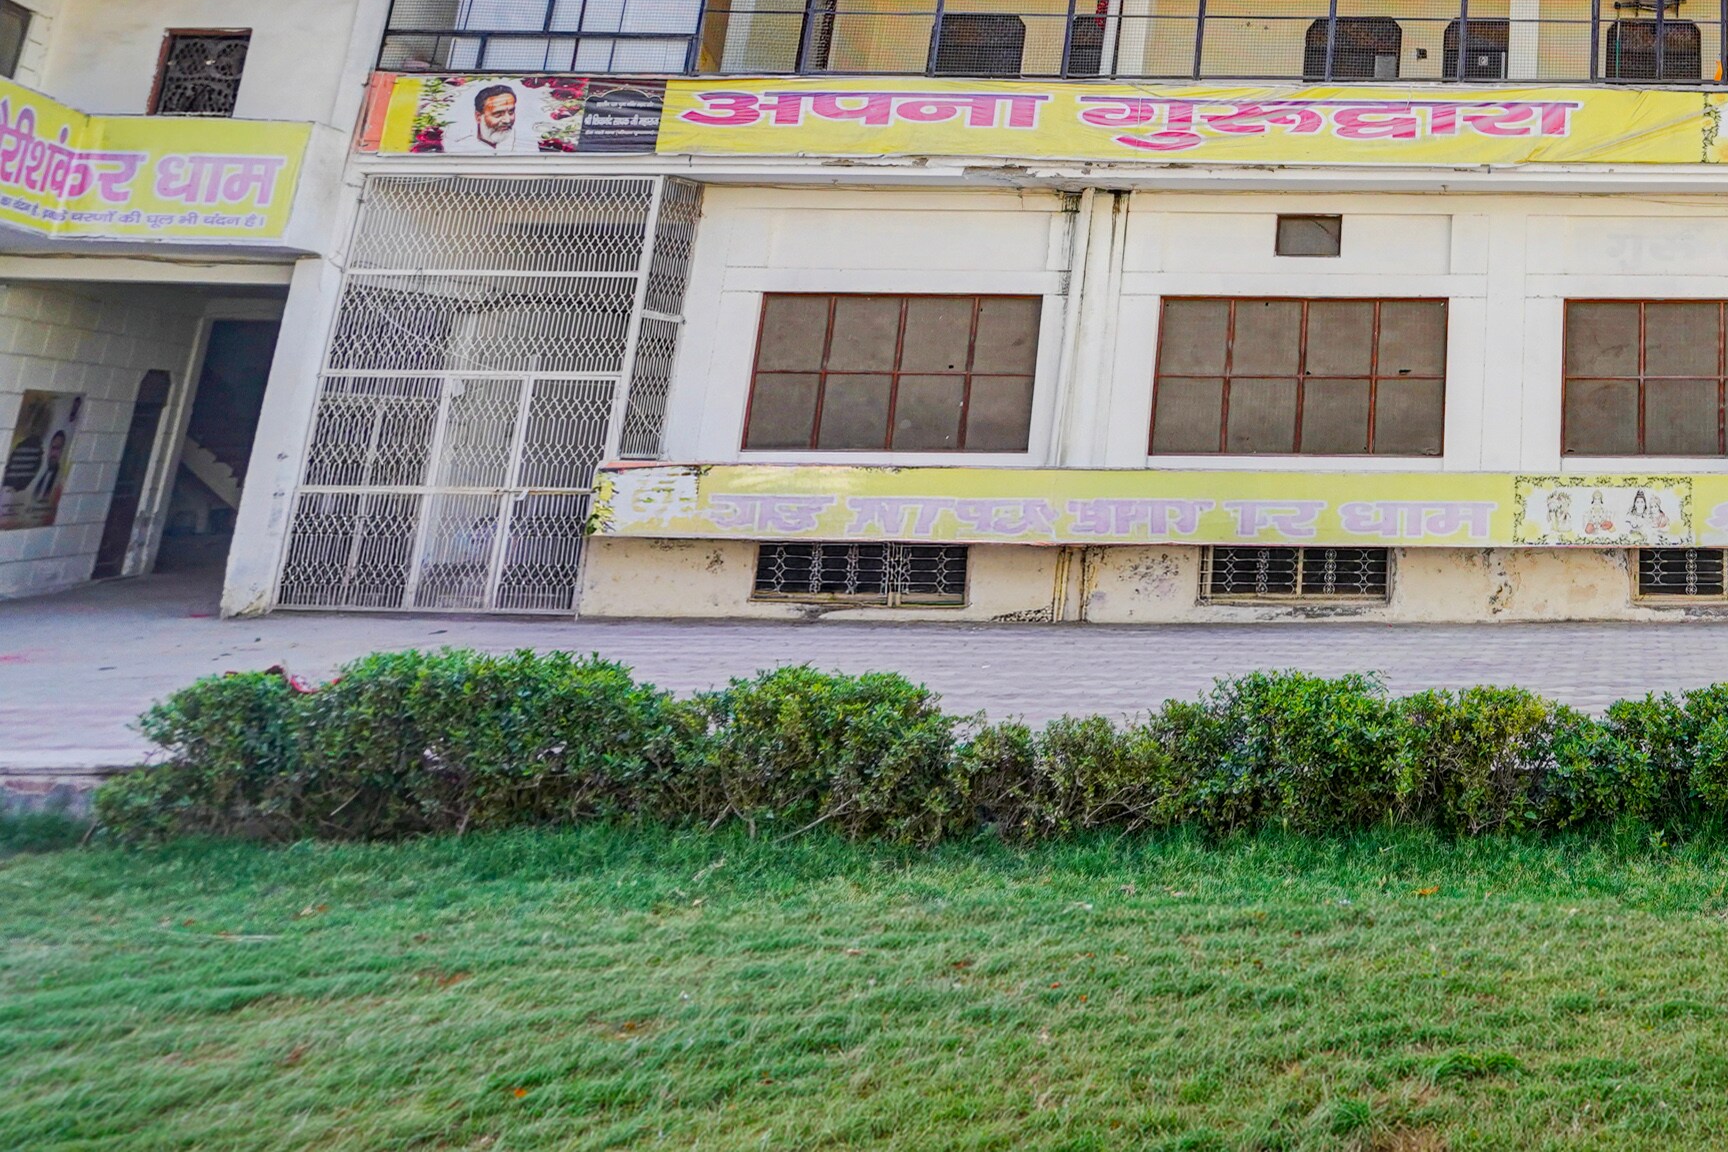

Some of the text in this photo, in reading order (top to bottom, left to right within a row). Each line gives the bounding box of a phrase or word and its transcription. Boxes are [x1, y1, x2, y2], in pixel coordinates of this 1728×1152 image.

[680, 91, 1053, 131] अपना
[155, 152, 286, 205] धाम
[1339, 500, 1497, 538] धाम
